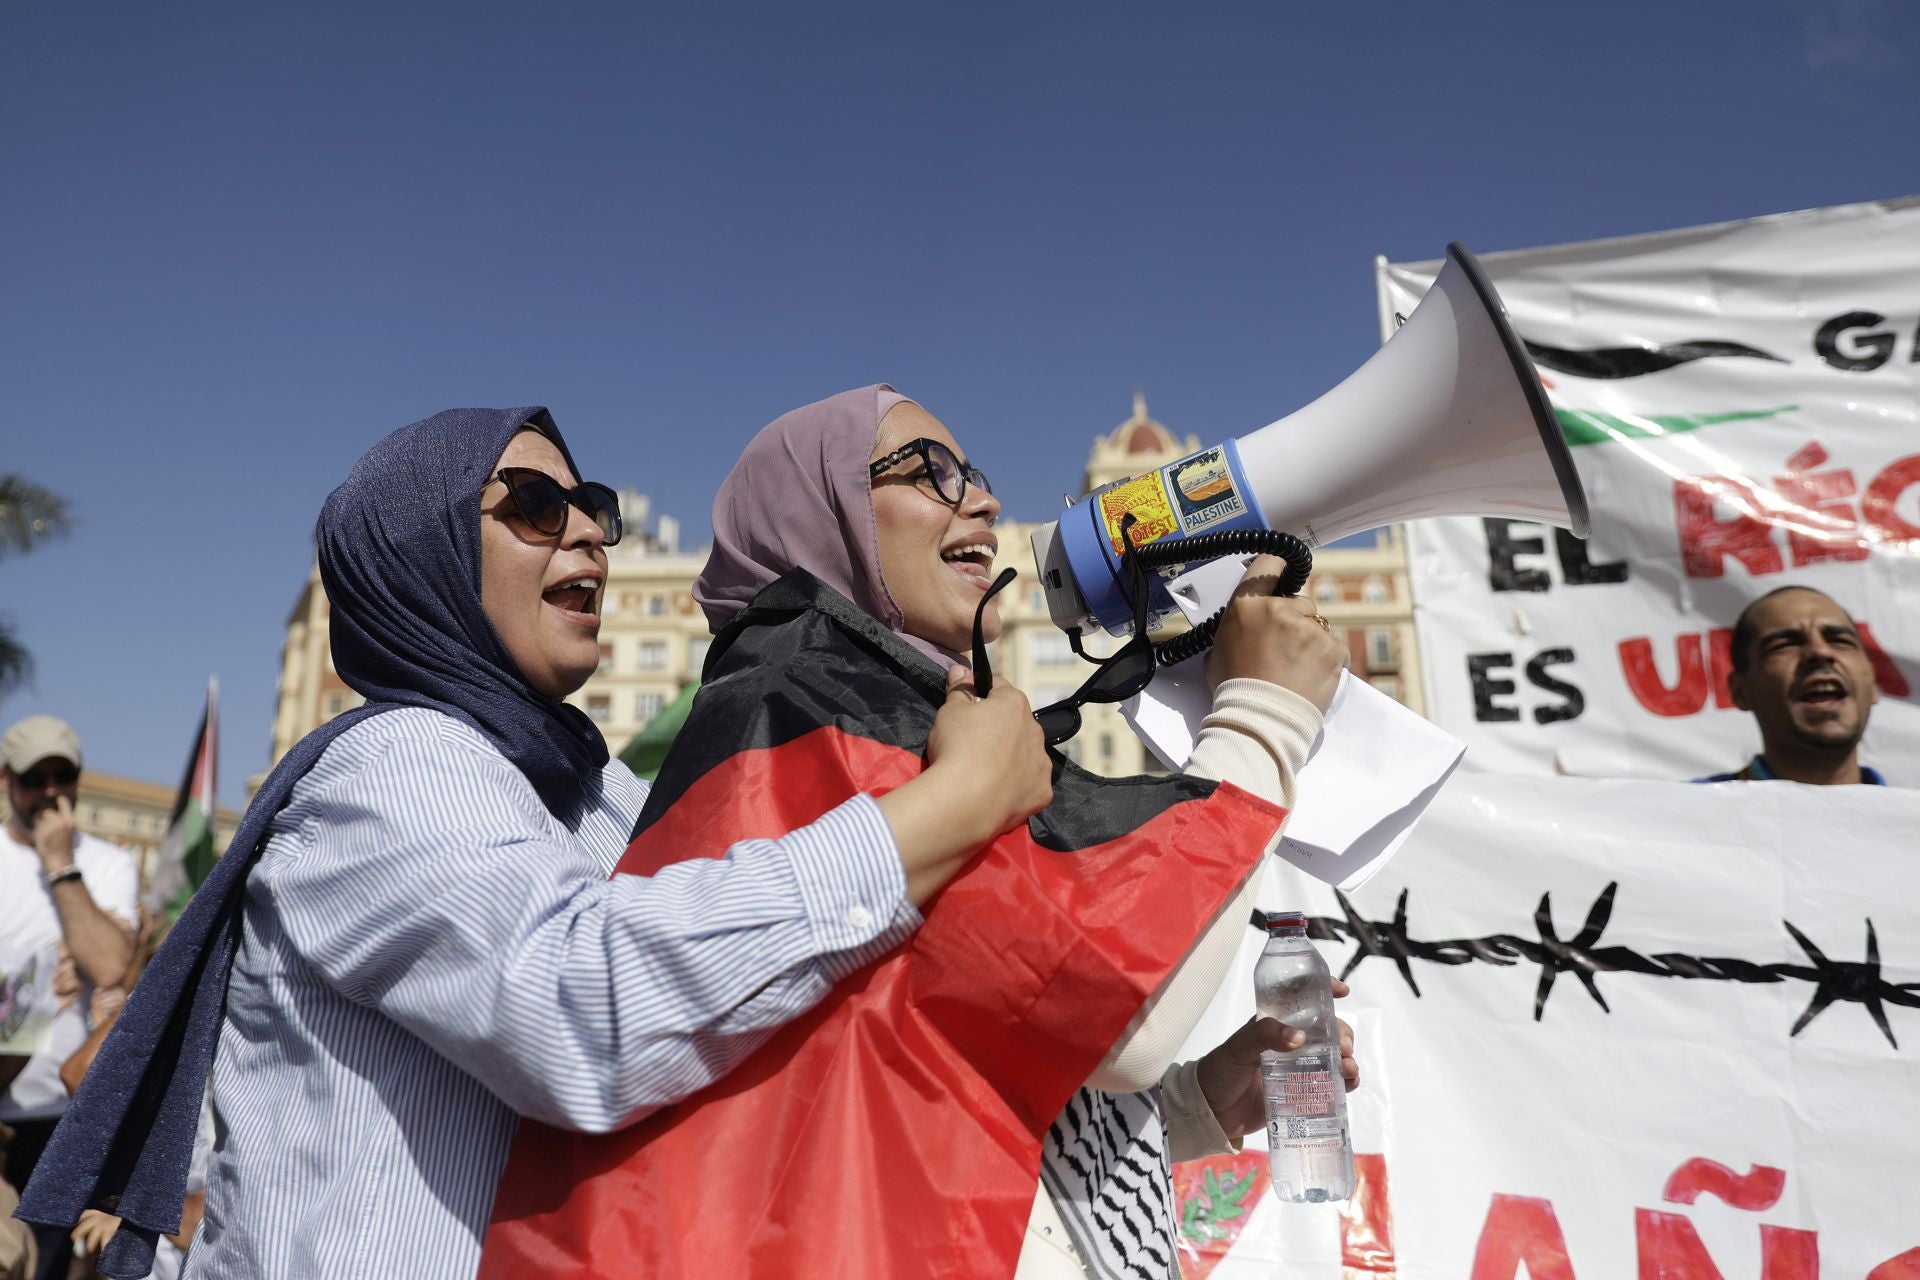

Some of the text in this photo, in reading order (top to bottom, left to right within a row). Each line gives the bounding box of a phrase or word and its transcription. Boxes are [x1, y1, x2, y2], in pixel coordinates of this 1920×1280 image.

[1814, 310, 1920, 372] G
[1184, 499, 1240, 529] PALESTINE
[1482, 516, 1629, 593] EL
[1468, 647, 1584, 725] ES
[1470, 1157, 1920, 1280] AÑ
